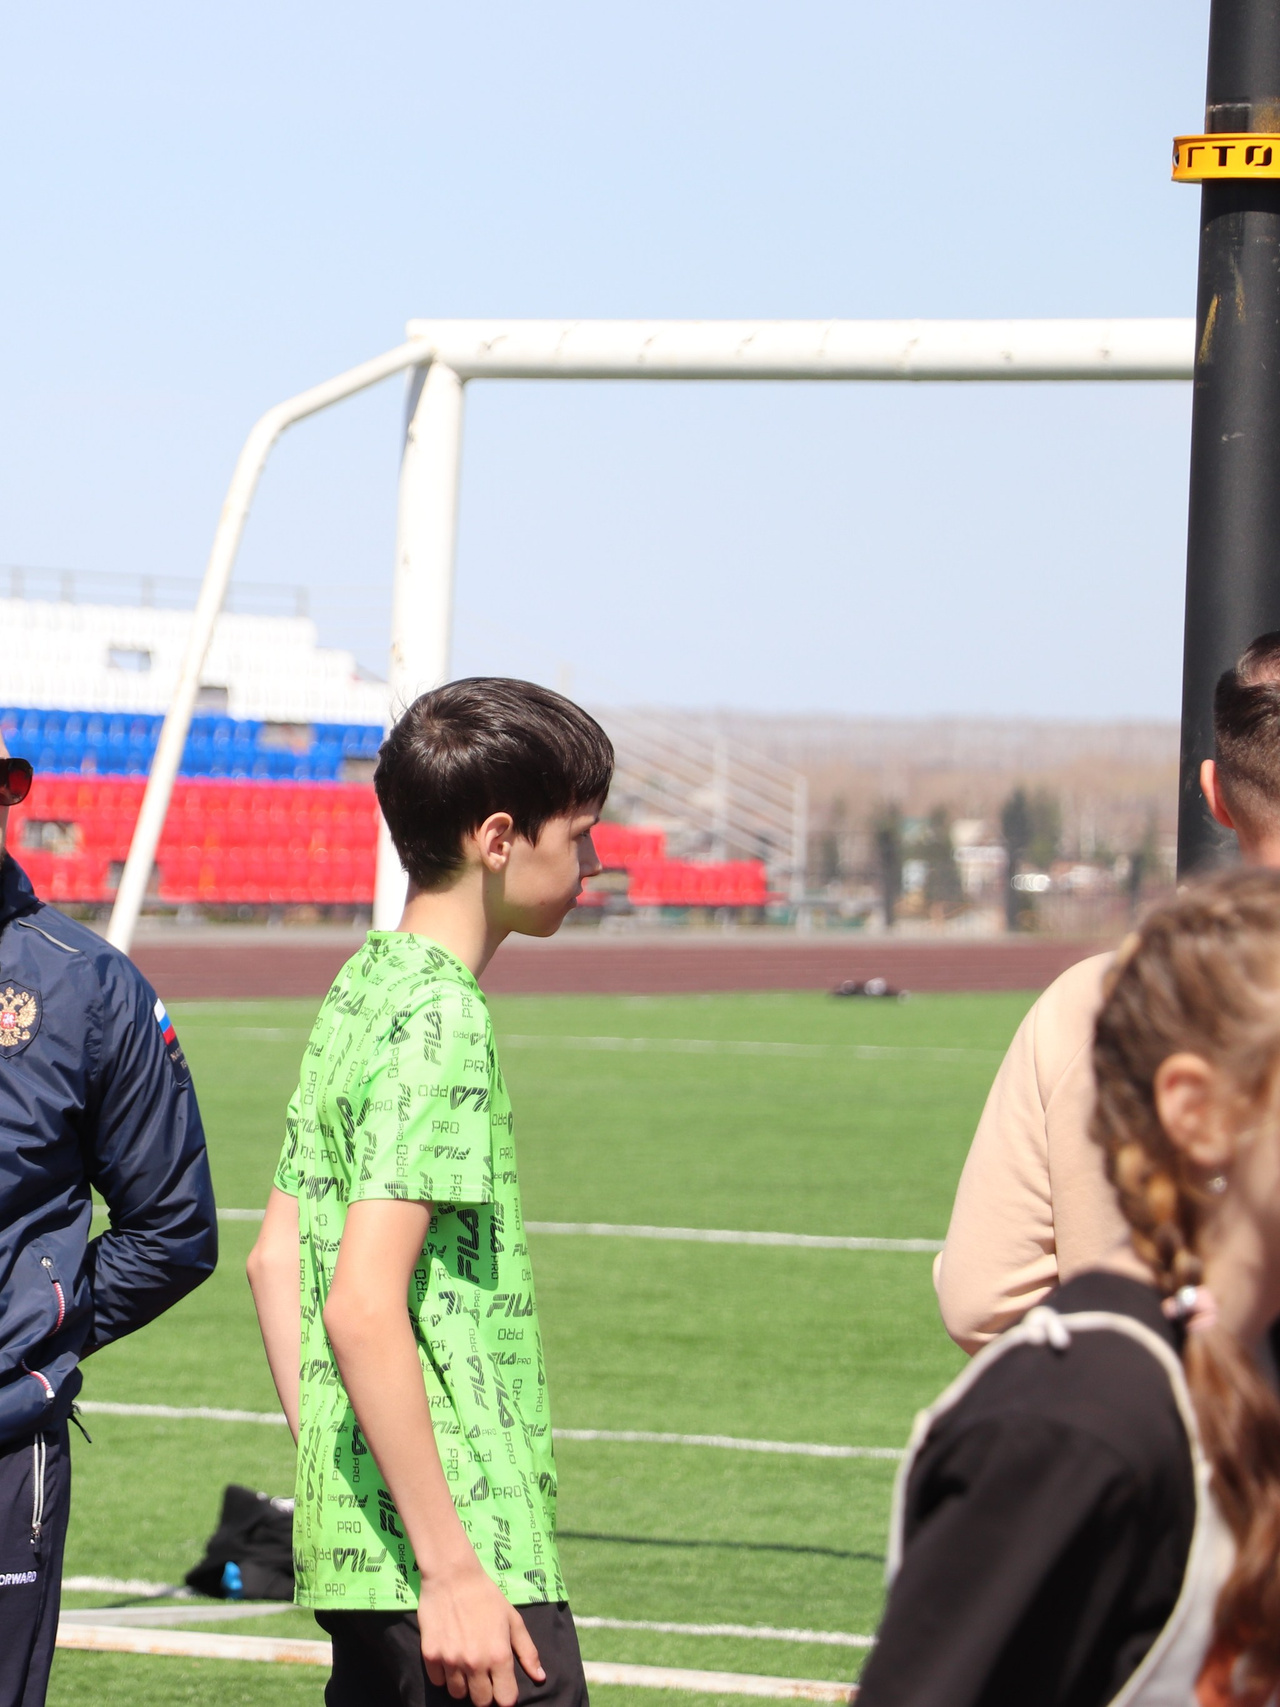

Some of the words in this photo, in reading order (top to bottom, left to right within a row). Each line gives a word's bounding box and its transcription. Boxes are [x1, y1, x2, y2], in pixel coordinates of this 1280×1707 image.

[1187, 145, 1273, 168] ГТО
[423, 1011, 442, 1066] FILA
[388, 1047, 400, 1079] PRO
[304, 1070, 318, 1105] PRO
[417, 1085, 449, 1099] PRO
[431, 1120, 460, 1134] PRO
[396, 1144, 408, 1177] PRO
[434, 1145, 472, 1160] FILA
[489, 1200, 505, 1254] FILA
[456, 1208, 480, 1284] FILA
[486, 1292, 533, 1318] FILA
[468, 1328, 478, 1353] PRO
[497, 1328, 524, 1340] PRO
[517, 1357, 532, 1365] PRO
[466, 1355, 489, 1411] FILA
[428, 1396, 452, 1409] RO
[536, 1388, 544, 1413] PRO
[503, 1431, 517, 1464] PRO
[332, 1446, 342, 1481] PRO
[352, 1457, 361, 1483] PRO
[446, 1447, 459, 1481] PRO
[338, 1494, 368, 1508] FILA
[492, 1485, 522, 1499] PRO
[337, 1521, 362, 1534] PRO
[398, 1544, 406, 1562] PRO
[492, 1515, 512, 1571] FILA
[533, 1532, 545, 1566] PRO
[332, 1547, 388, 1573] FILA
[324, 1583, 346, 1597] PRO
